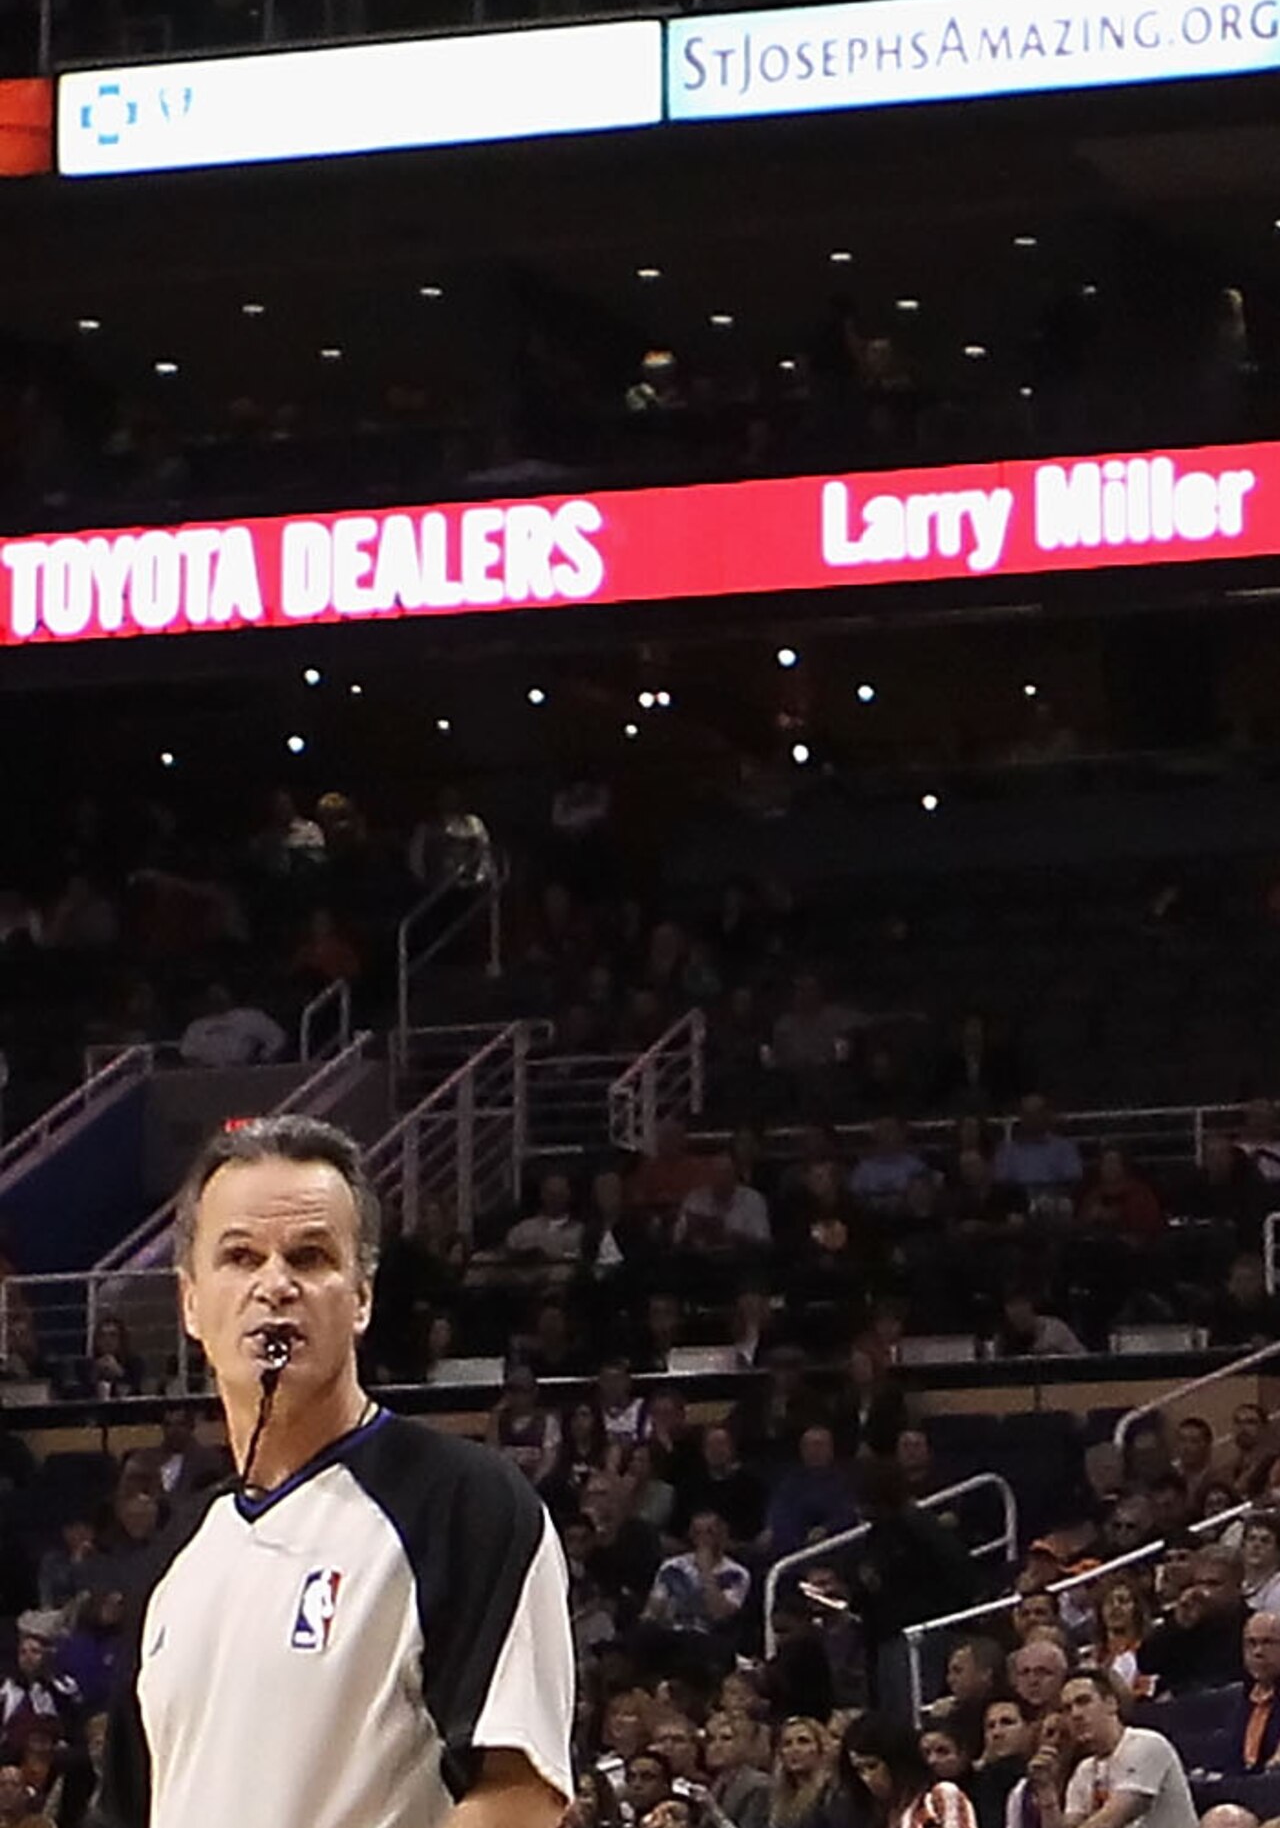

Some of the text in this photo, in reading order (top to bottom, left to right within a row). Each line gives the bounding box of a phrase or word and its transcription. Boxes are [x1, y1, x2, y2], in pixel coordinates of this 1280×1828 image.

[2, 499, 605, 637] TOYOTA DEALERS
[822, 455, 1256, 572] Larry Miller
